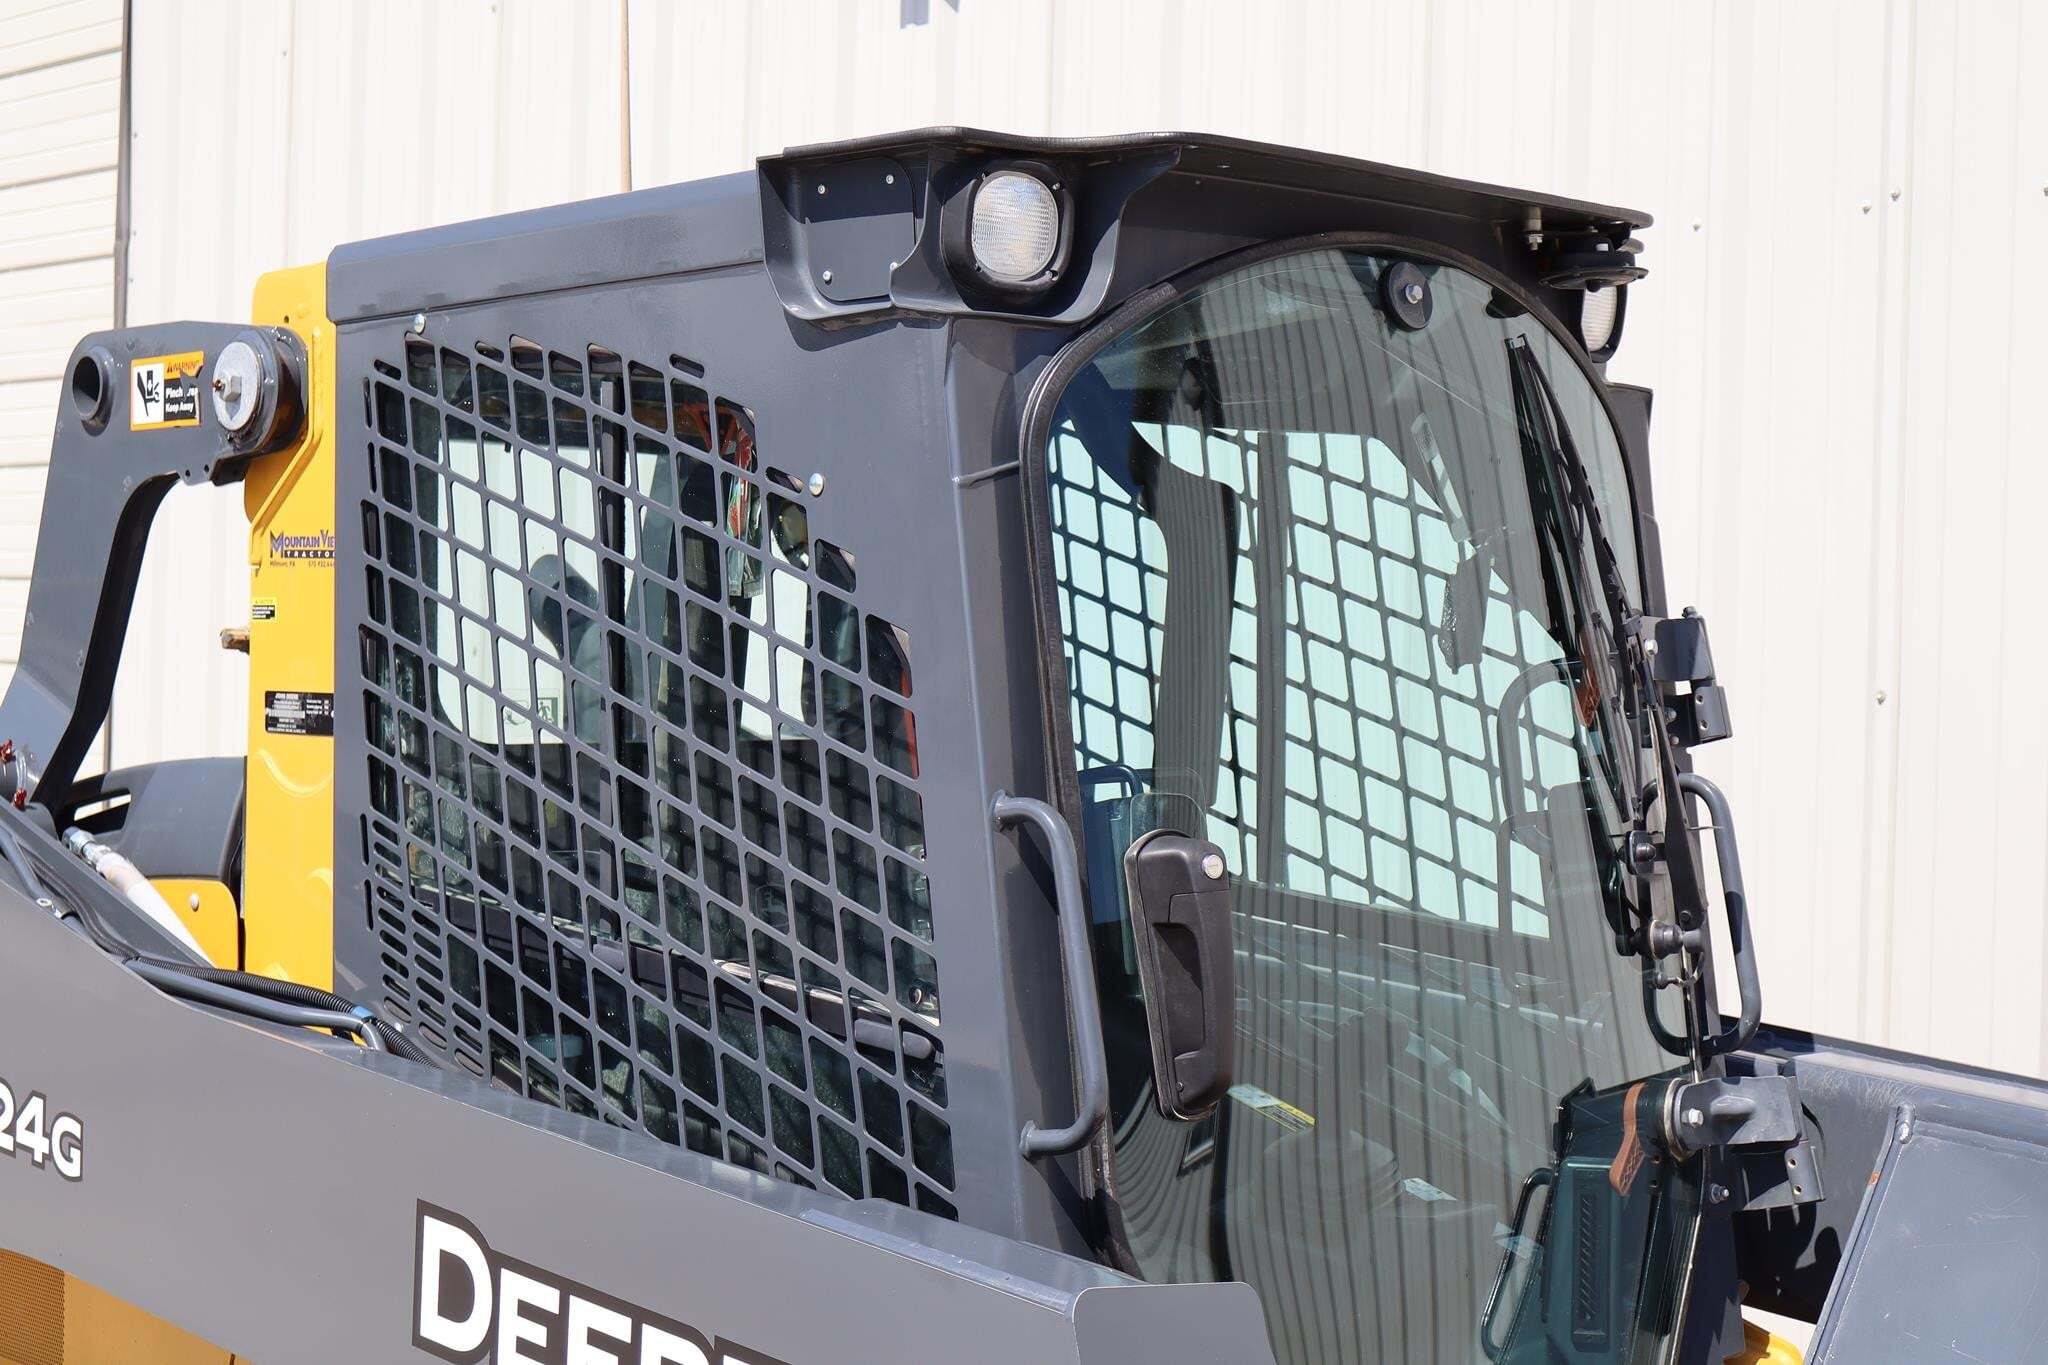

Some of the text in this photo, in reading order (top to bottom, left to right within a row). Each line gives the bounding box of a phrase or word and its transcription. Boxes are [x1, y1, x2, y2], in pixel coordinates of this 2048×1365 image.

[165, 386, 184, 399] Pinch
[165, 402, 195, 414] Keep Away
[420, 1214, 750, 1365] DEE
